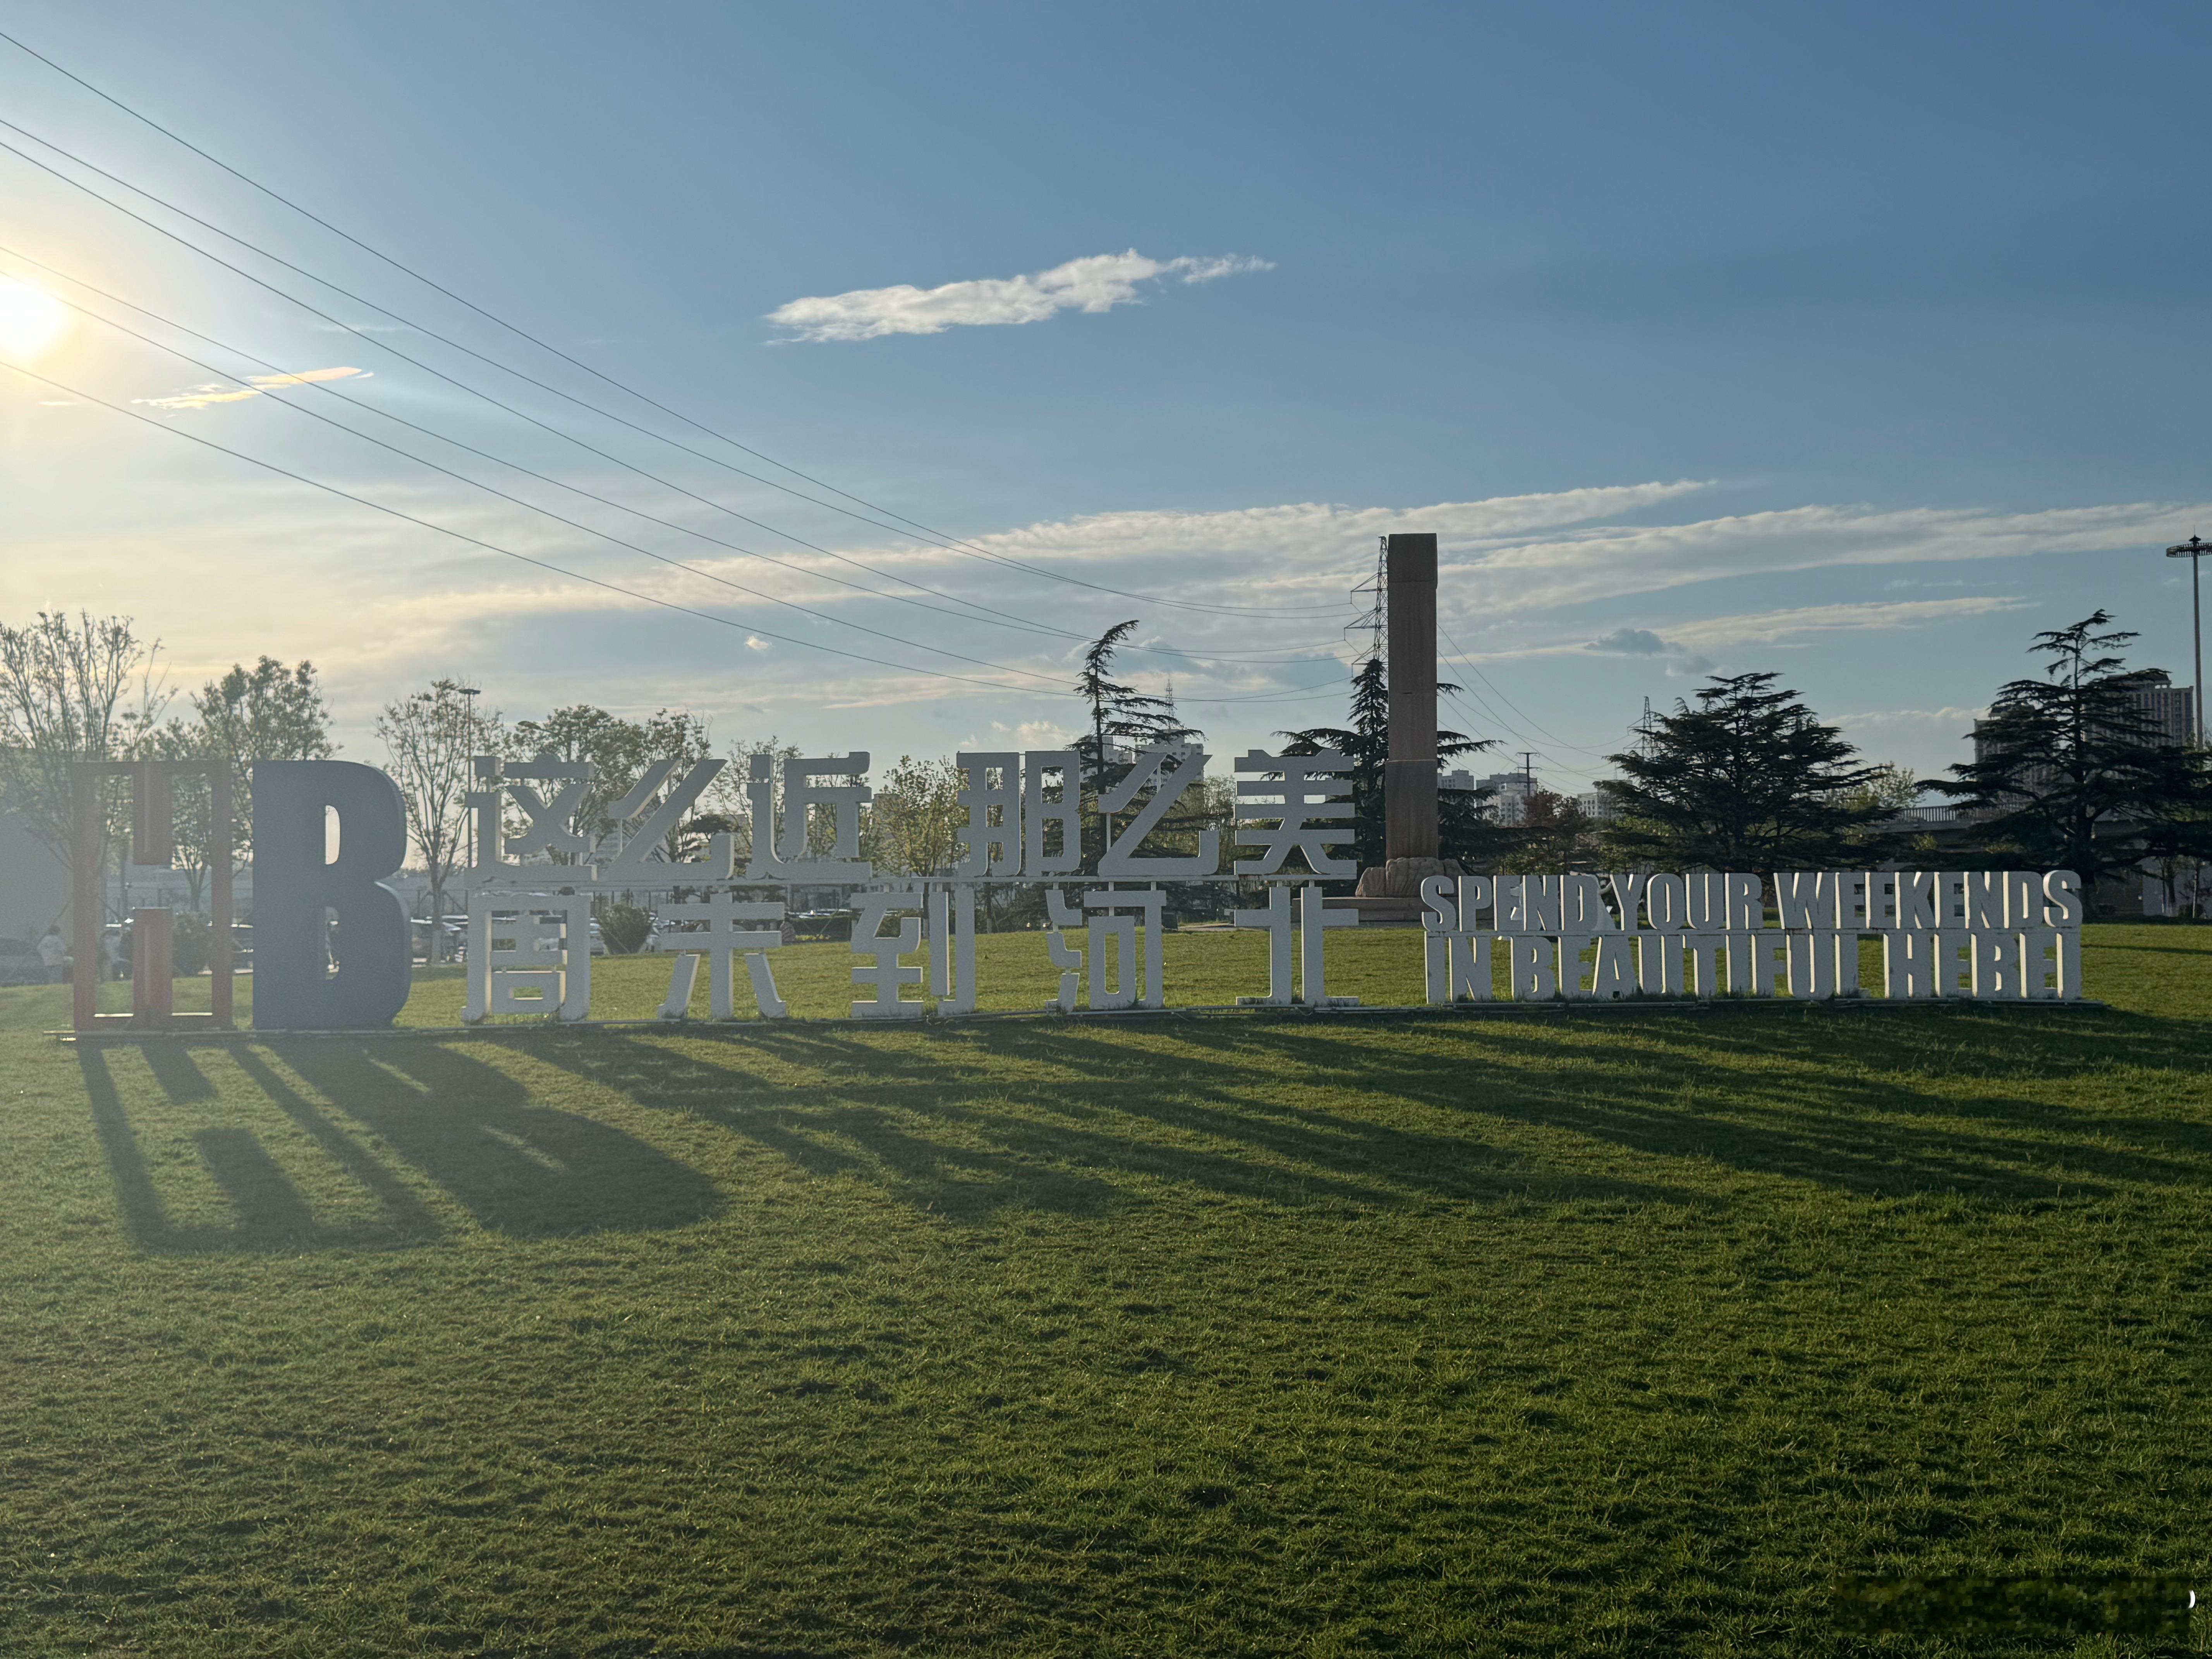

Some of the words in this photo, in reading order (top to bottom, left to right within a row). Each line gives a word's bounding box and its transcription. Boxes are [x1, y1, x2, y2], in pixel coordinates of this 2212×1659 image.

[465, 751, 872, 882] 这么近
[957, 750, 1357, 877] 那么美
[1421, 875, 1597, 931] SPEND
[1609, 873, 1763, 931] YOUR
[1773, 870, 2083, 930] WEEKENDS
[1424, 931, 1492, 1003] IN
[1511, 933, 1872, 1003] BEAUTIFUL
[1883, 933, 2081, 999] HEBEI
